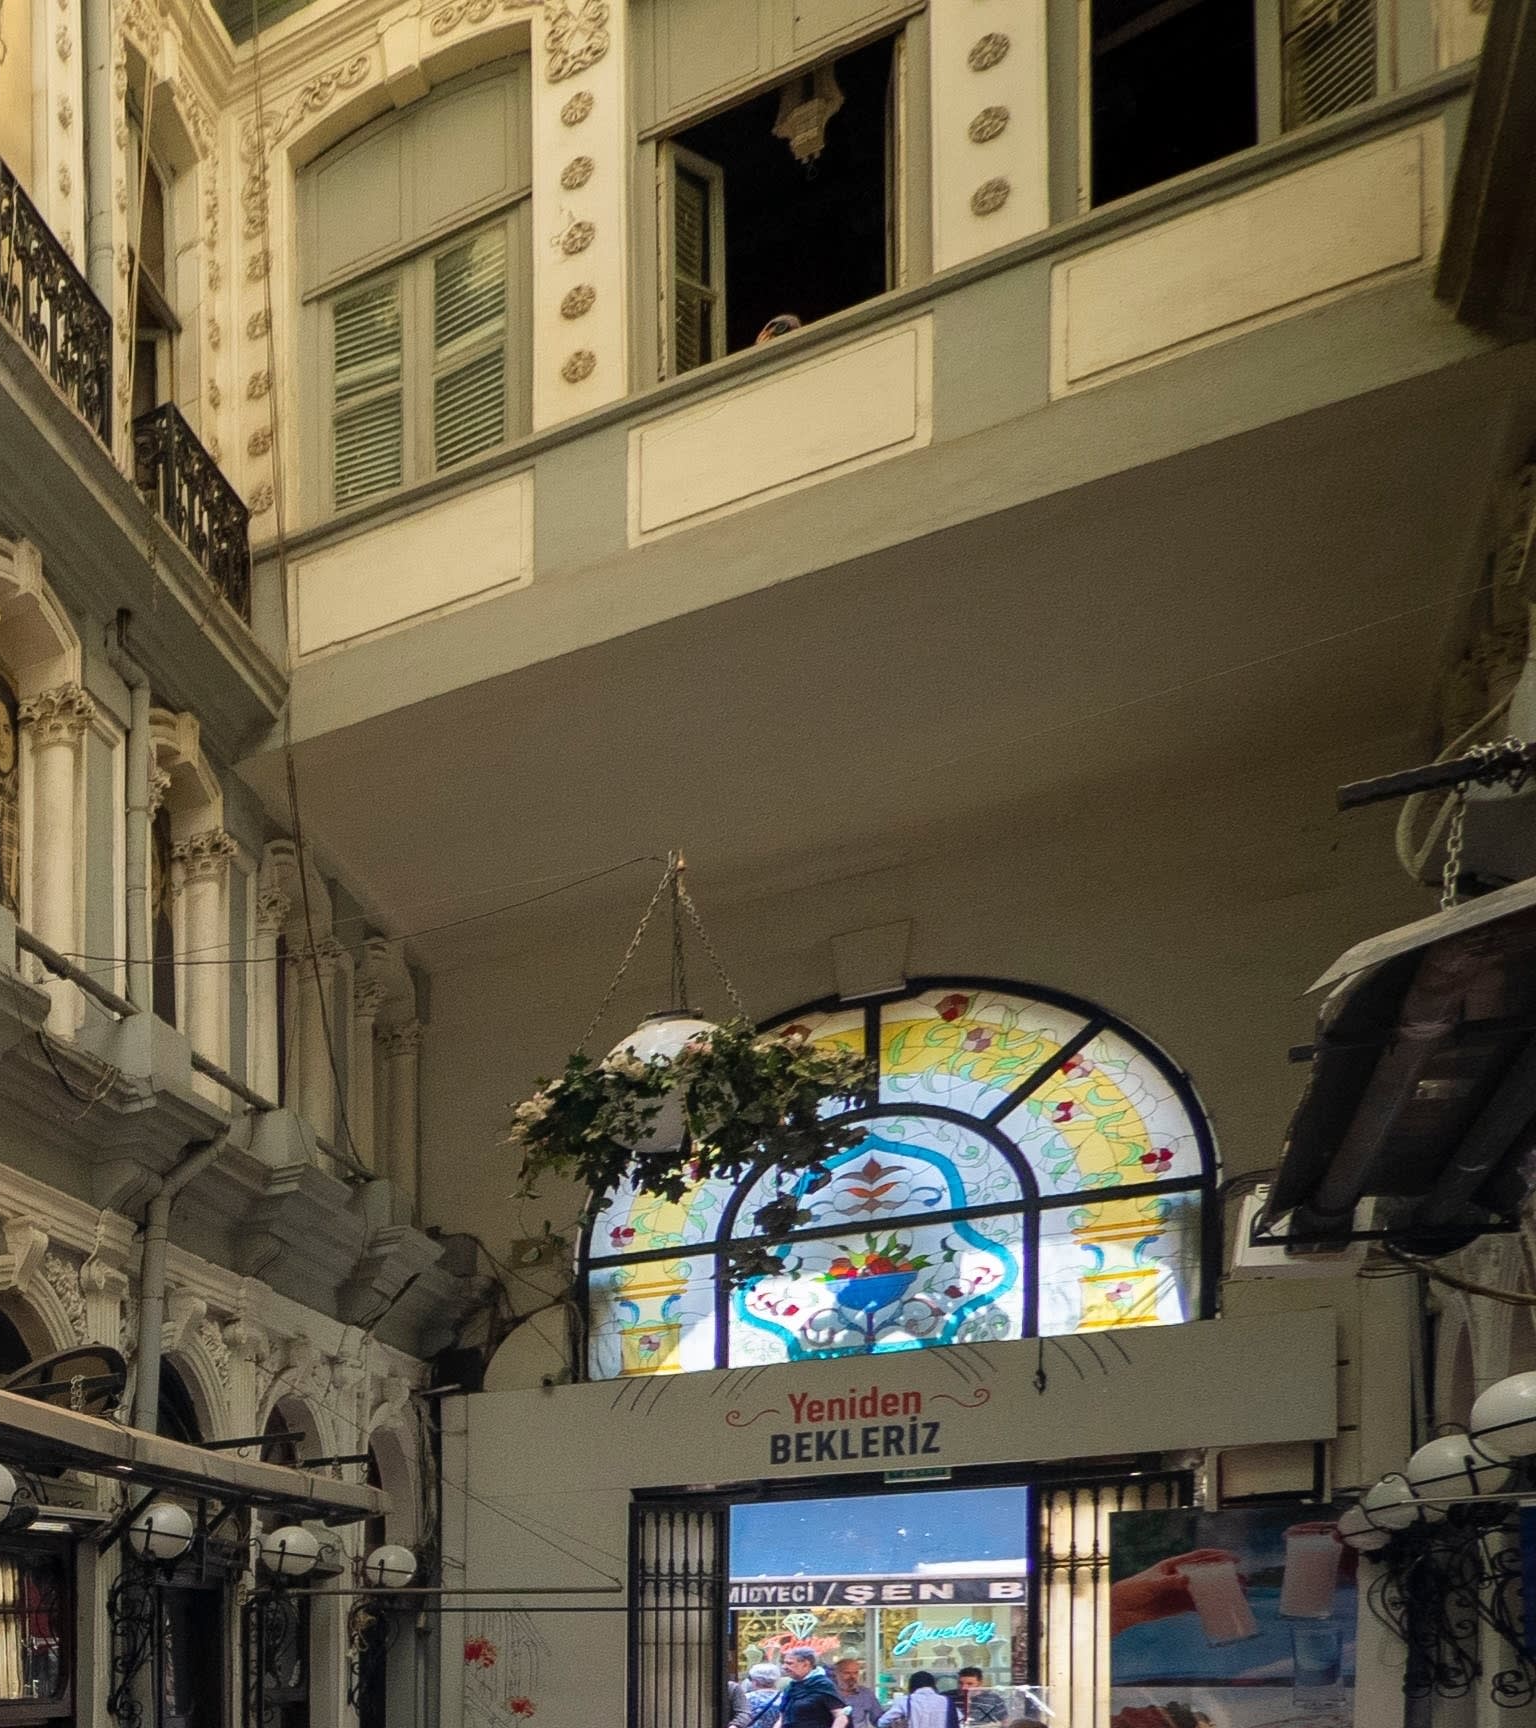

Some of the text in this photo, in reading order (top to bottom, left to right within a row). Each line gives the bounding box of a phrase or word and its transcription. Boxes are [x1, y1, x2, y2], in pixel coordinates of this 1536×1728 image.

[788, 1386, 922, 1424] Yeniden
[770, 1415, 941, 1465] BEKLERİZ
[842, 1583, 955, 1605] ŞEN
[893, 1617, 996, 1656] Jewellery
